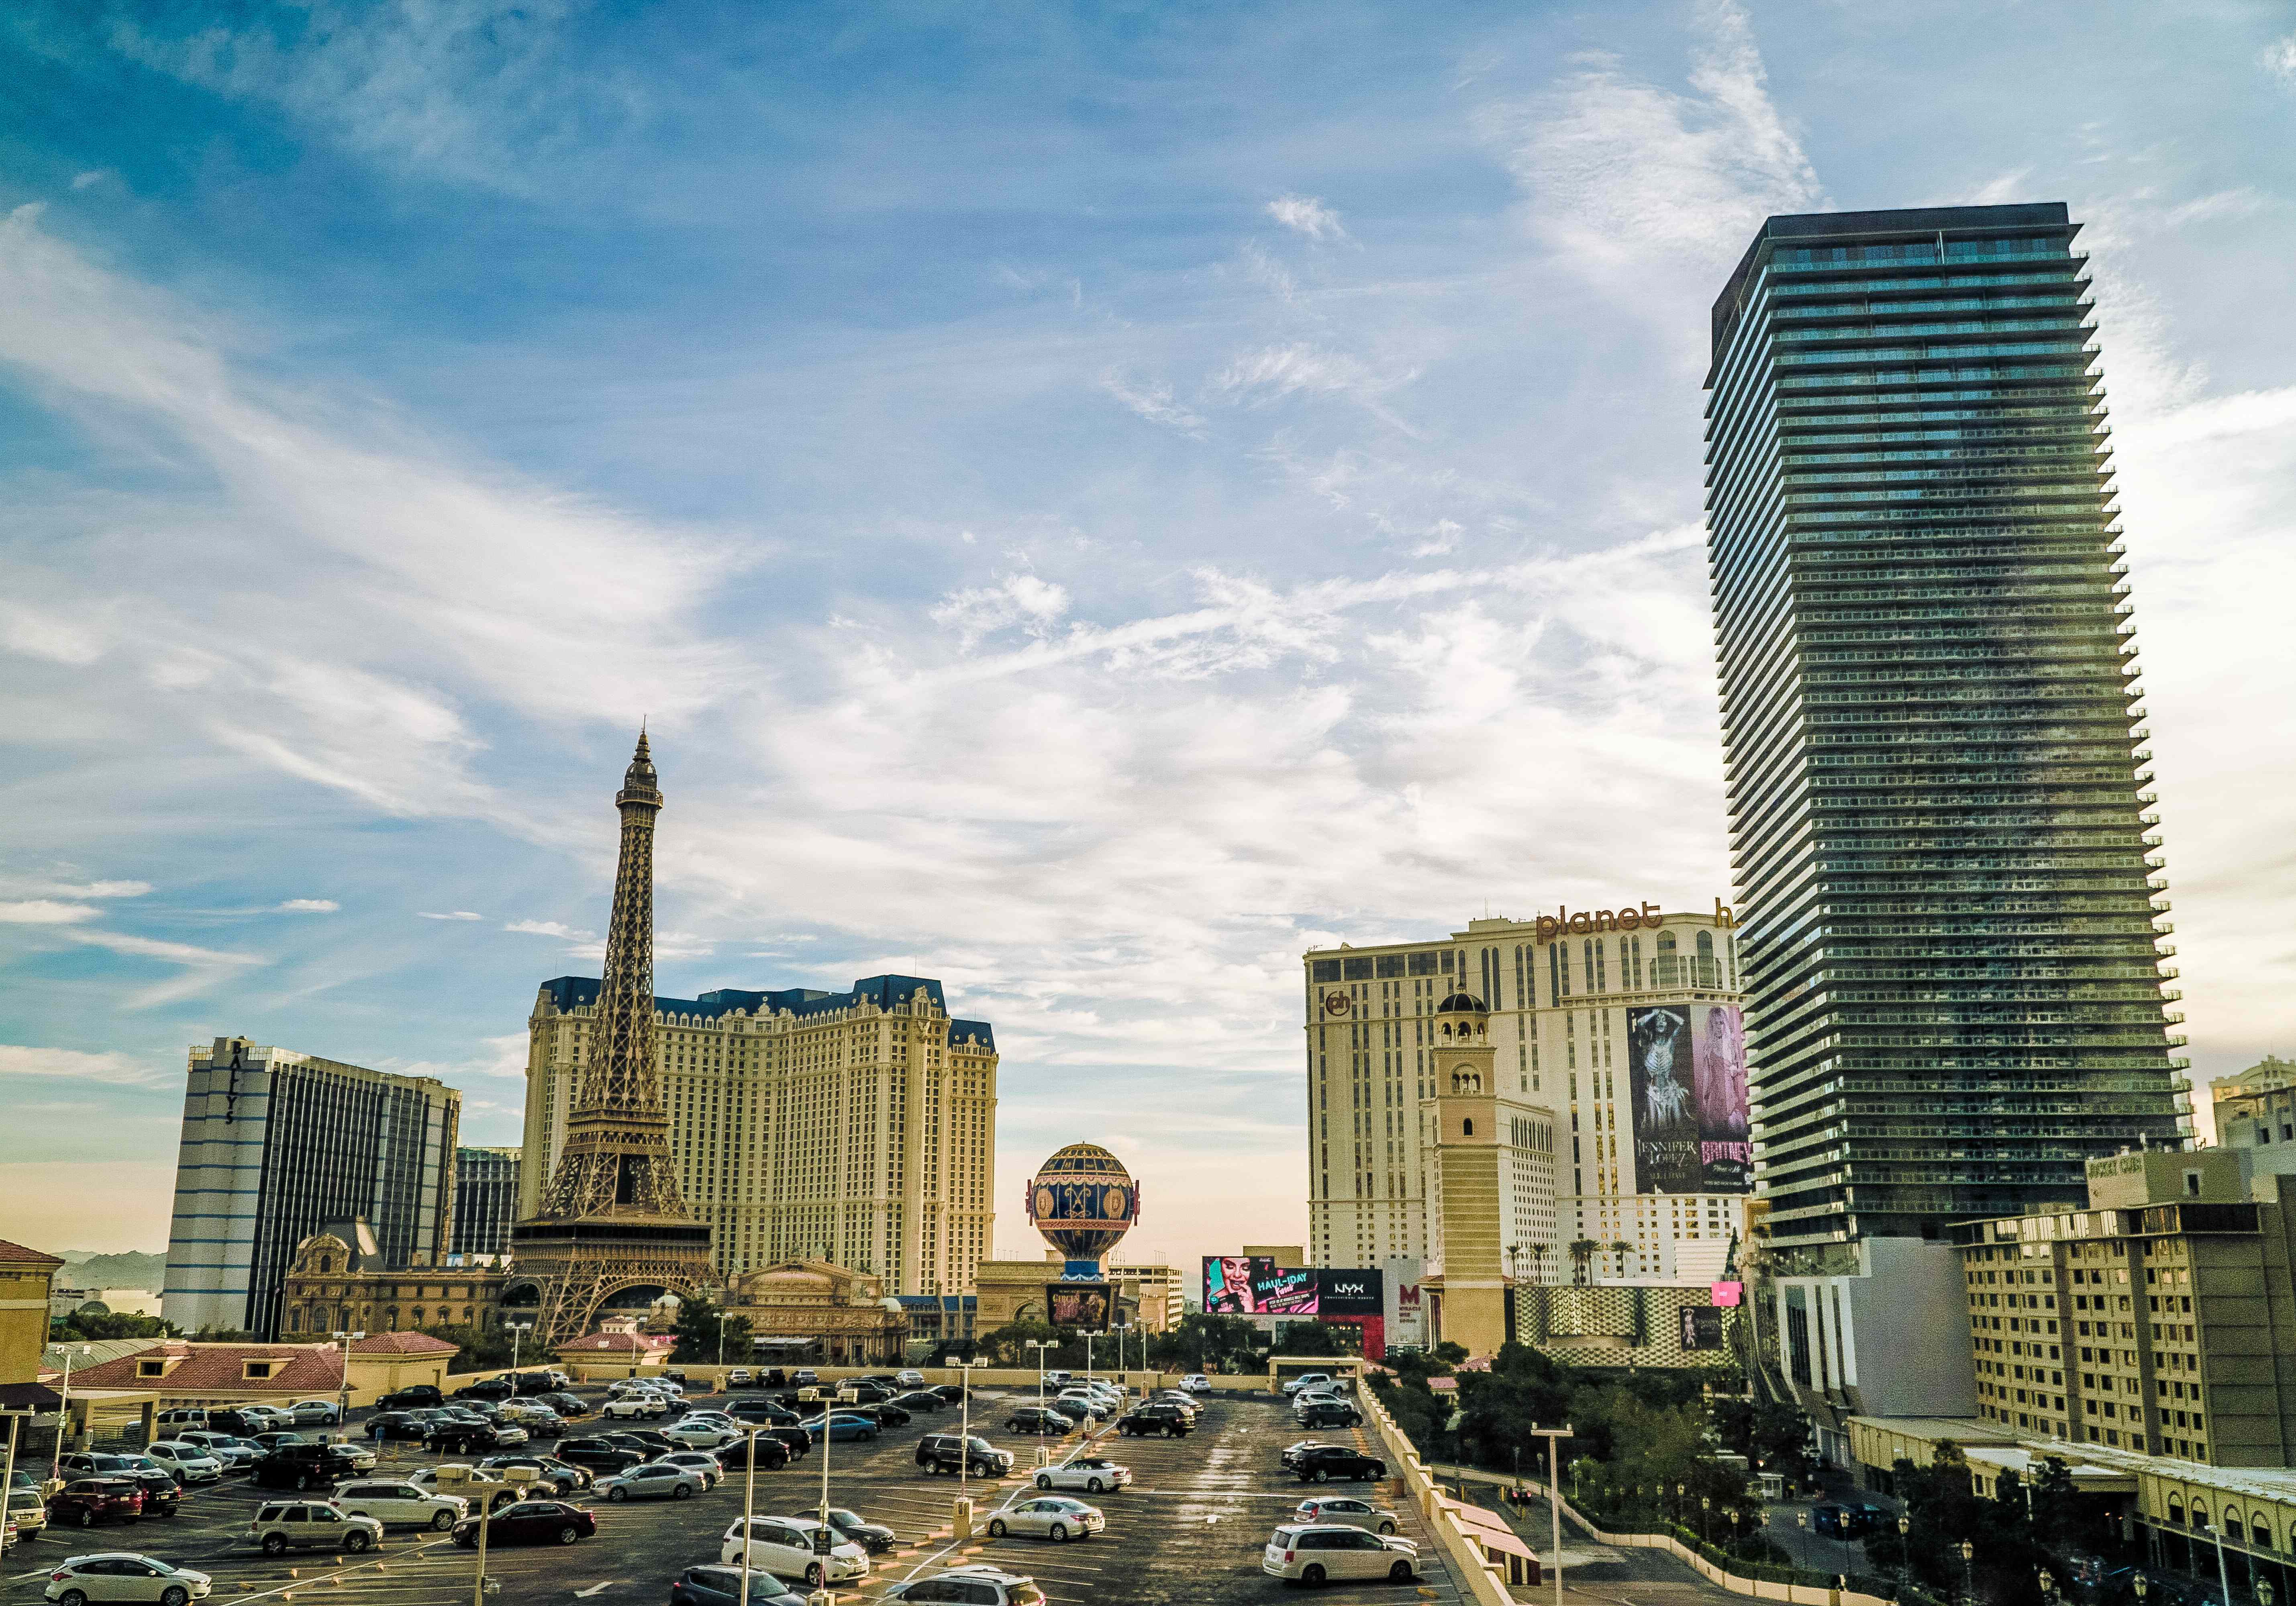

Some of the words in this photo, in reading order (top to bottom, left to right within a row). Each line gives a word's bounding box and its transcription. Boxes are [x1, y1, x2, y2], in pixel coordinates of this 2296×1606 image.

[1536, 901, 1662, 945] planet
[1637, 1139, 1696, 1156] JENNIFER
[1701, 1141, 1751, 1166] BRITNEY
[1257, 1272, 1307, 1292] HAUL-IDAY
[1335, 1283, 1363, 1295] NYX
[1400, 1284, 1420, 1304] M
